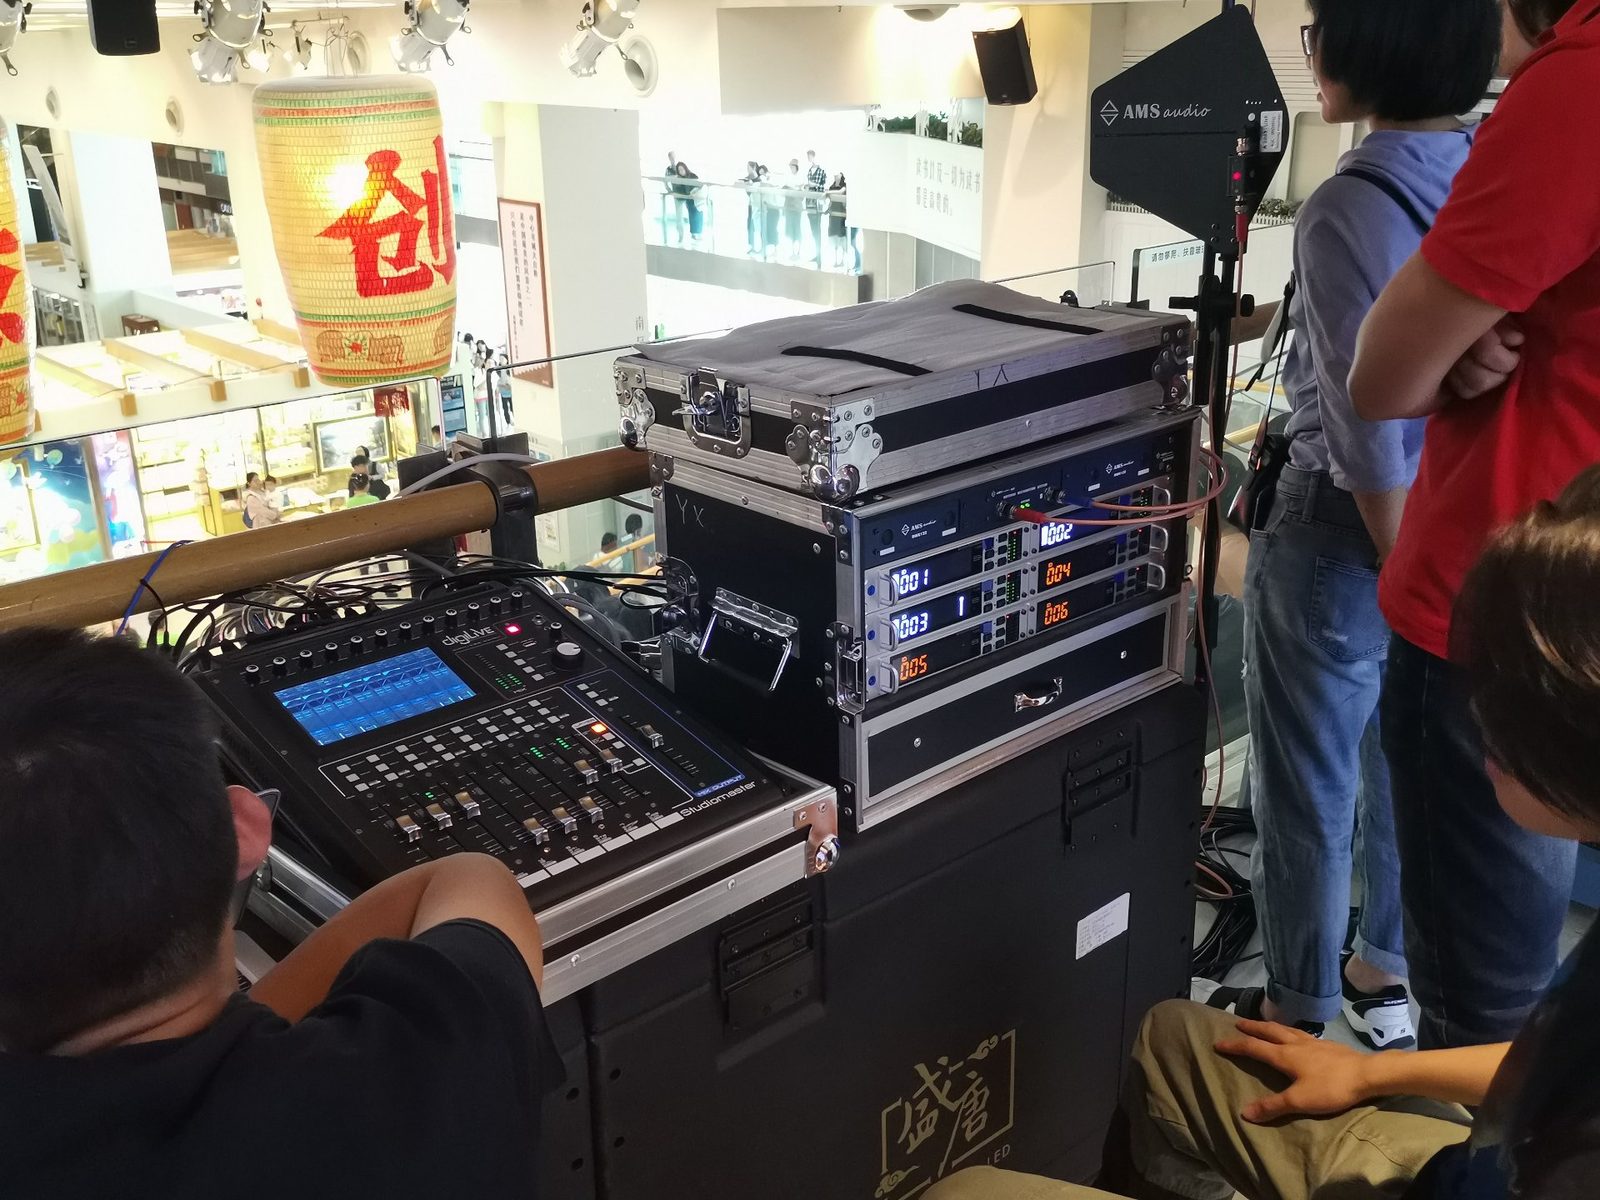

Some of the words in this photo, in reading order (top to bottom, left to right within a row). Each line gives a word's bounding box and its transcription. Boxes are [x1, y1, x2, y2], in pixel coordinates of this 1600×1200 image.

[1123, 103, 1160, 119] AMS
[1163, 103, 1212, 118] audio
[315, 134, 455, 298] 创
[899, 569, 929, 595] 001
[1046, 562, 1071, 586] 004
[899, 612, 929, 639] 003
[1044, 601, 1069, 625] 006
[900, 654, 928, 681] 005
[680, 781, 756, 817] Studiomaster
